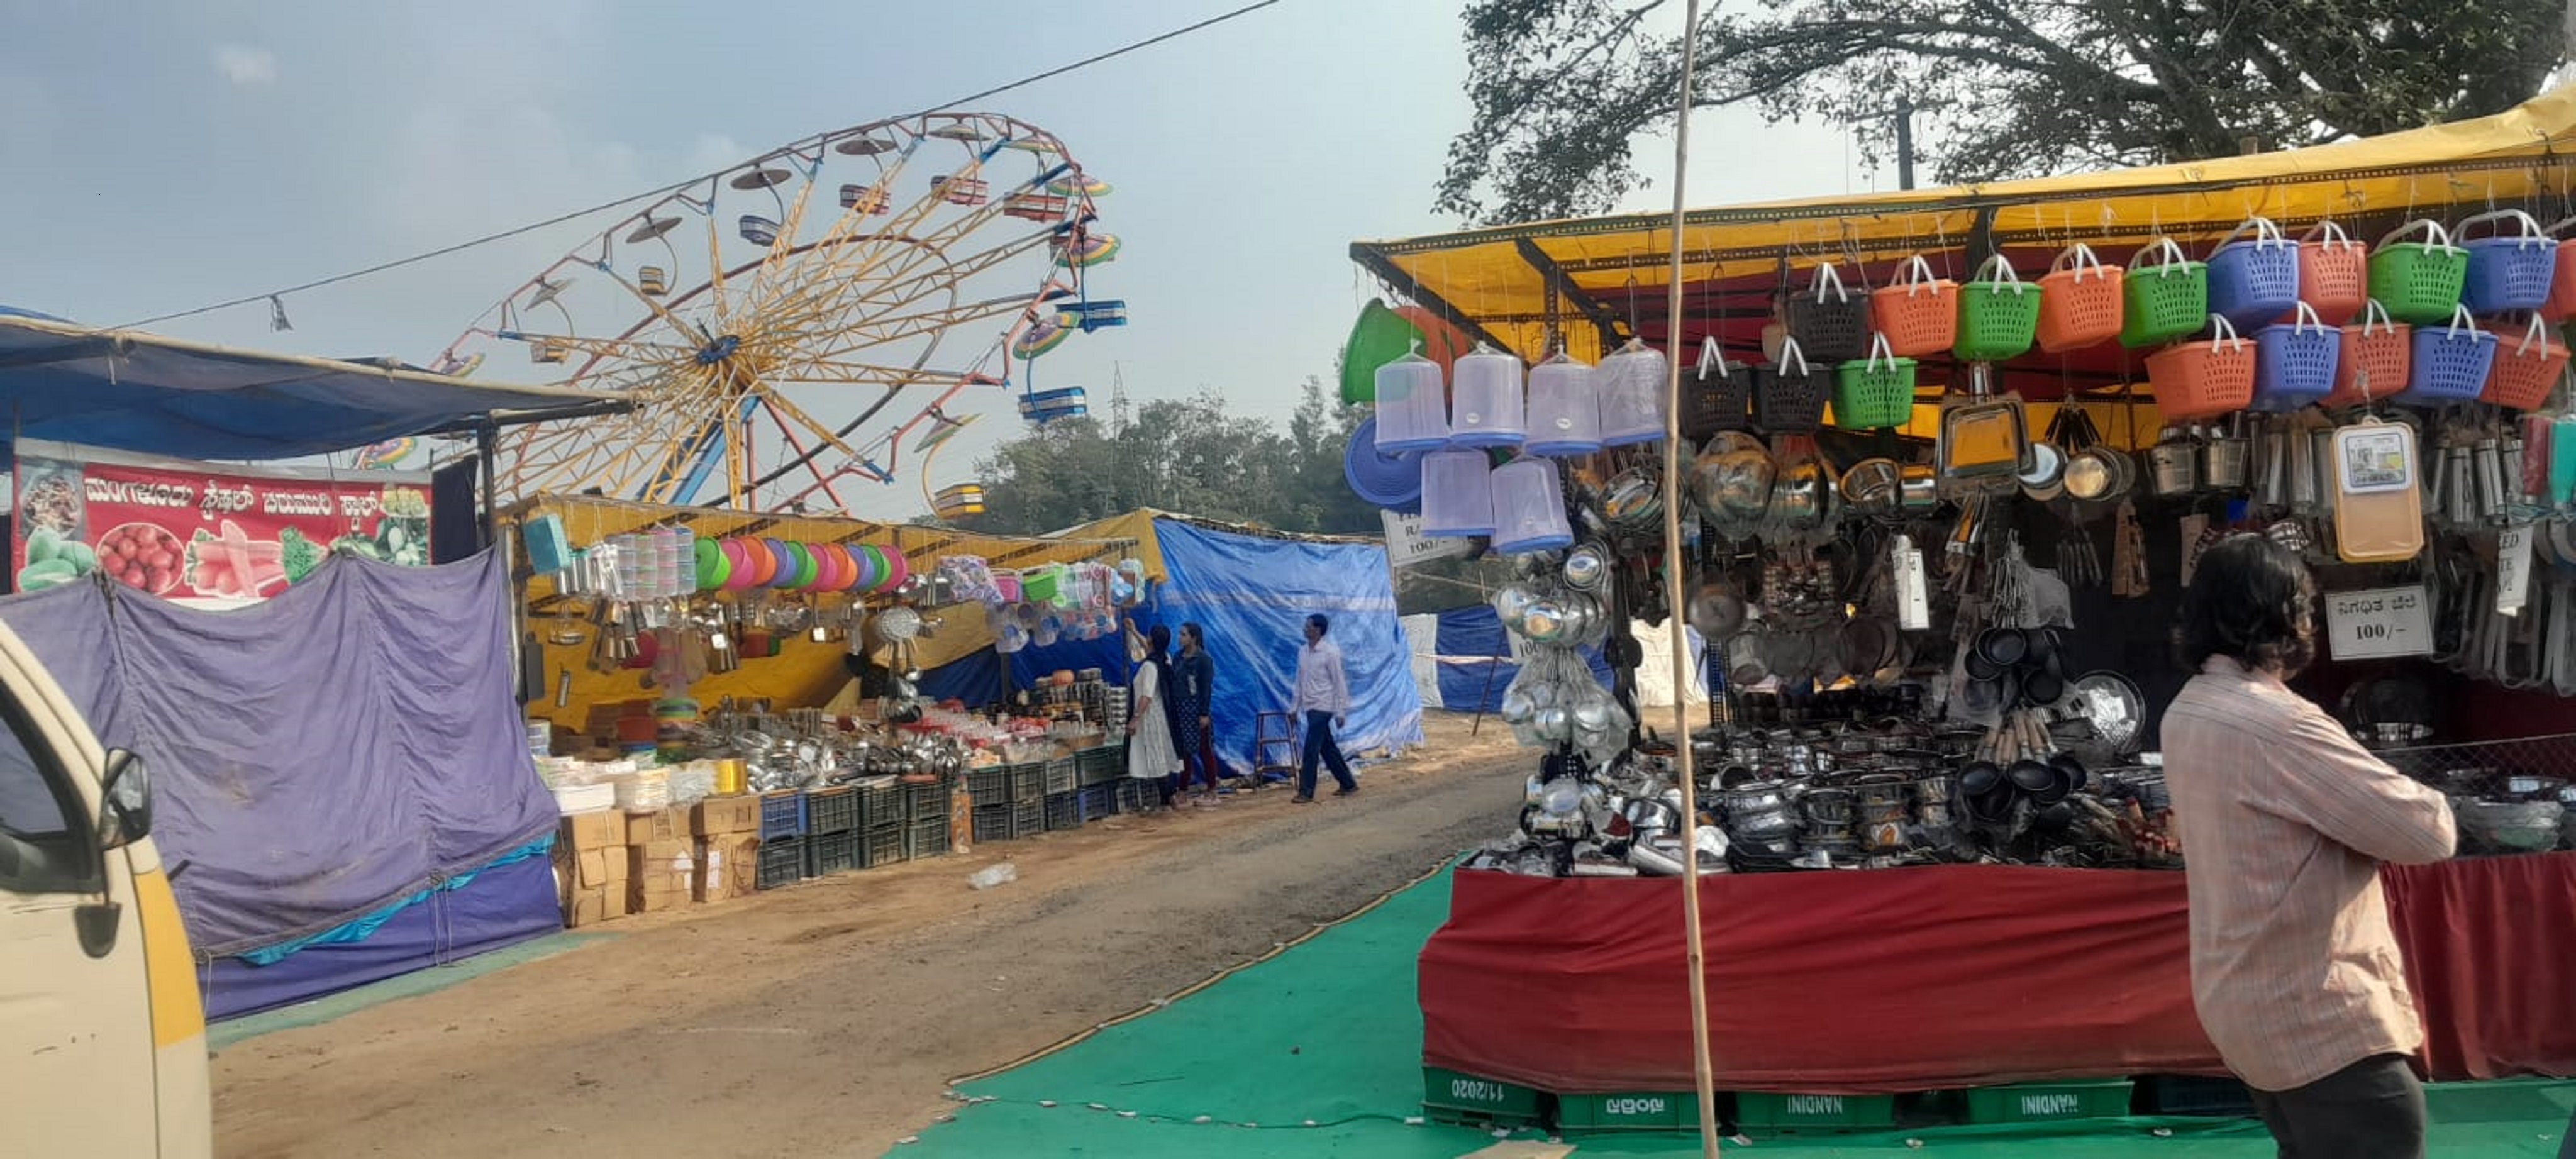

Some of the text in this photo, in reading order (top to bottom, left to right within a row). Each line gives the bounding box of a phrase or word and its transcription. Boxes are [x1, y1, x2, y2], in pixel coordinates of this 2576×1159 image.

[2356, 624, 2407, 641] 100/-
[1452, 1080, 1505, 1102] 11/2020
[1787, 1095, 1843, 1114] NANDINI
[2021, 1094, 2079, 1115] NANDINI
